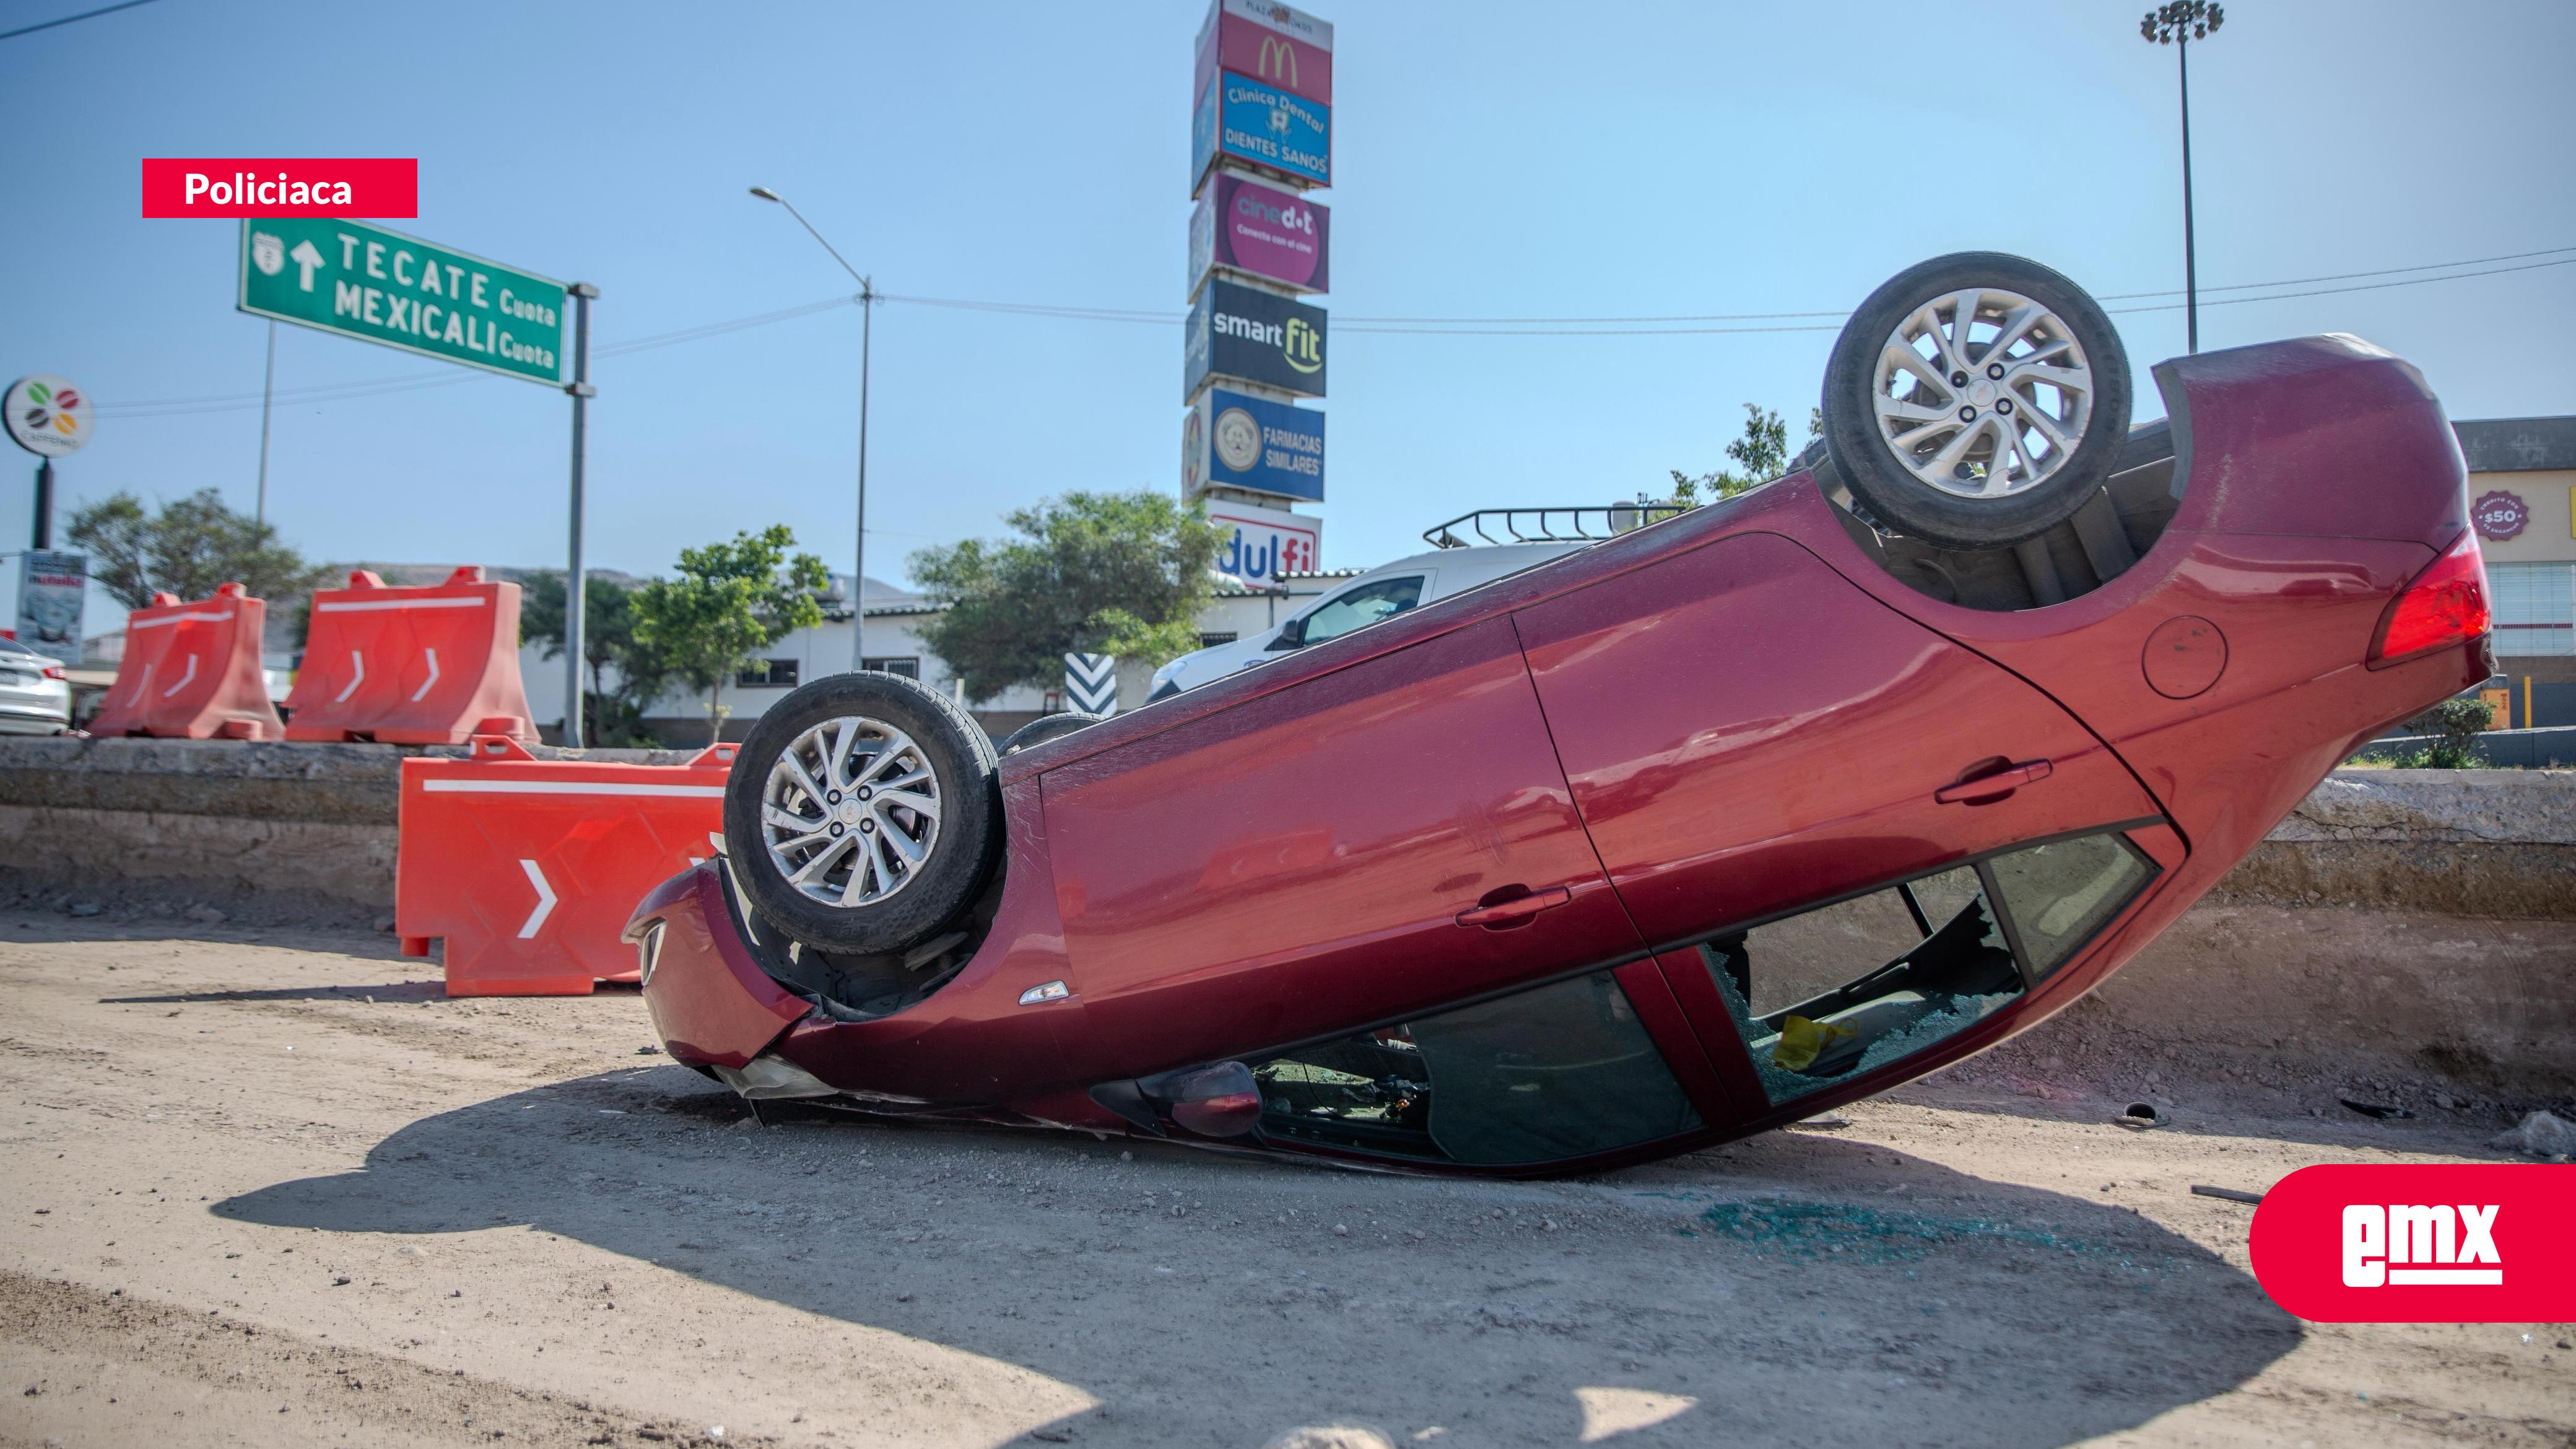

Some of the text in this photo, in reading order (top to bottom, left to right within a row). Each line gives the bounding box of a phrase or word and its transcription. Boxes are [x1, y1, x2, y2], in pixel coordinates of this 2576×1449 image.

[1279, 95, 1324, 134] Dental
[1225, 128, 1327, 173] DIENTES SANOS
[337, 233, 556, 327] TECATE Cuota
[334, 279, 555, 370] MEXICALI Cuota
[1214, 312, 1321, 363] smart fit
[1263, 426, 1321, 455] FARMACIAS
[1266, 449, 1320, 476] SIMILARES
[2484, 510, 2517, 523] $50
[1219, 528, 1310, 578] dulfi
